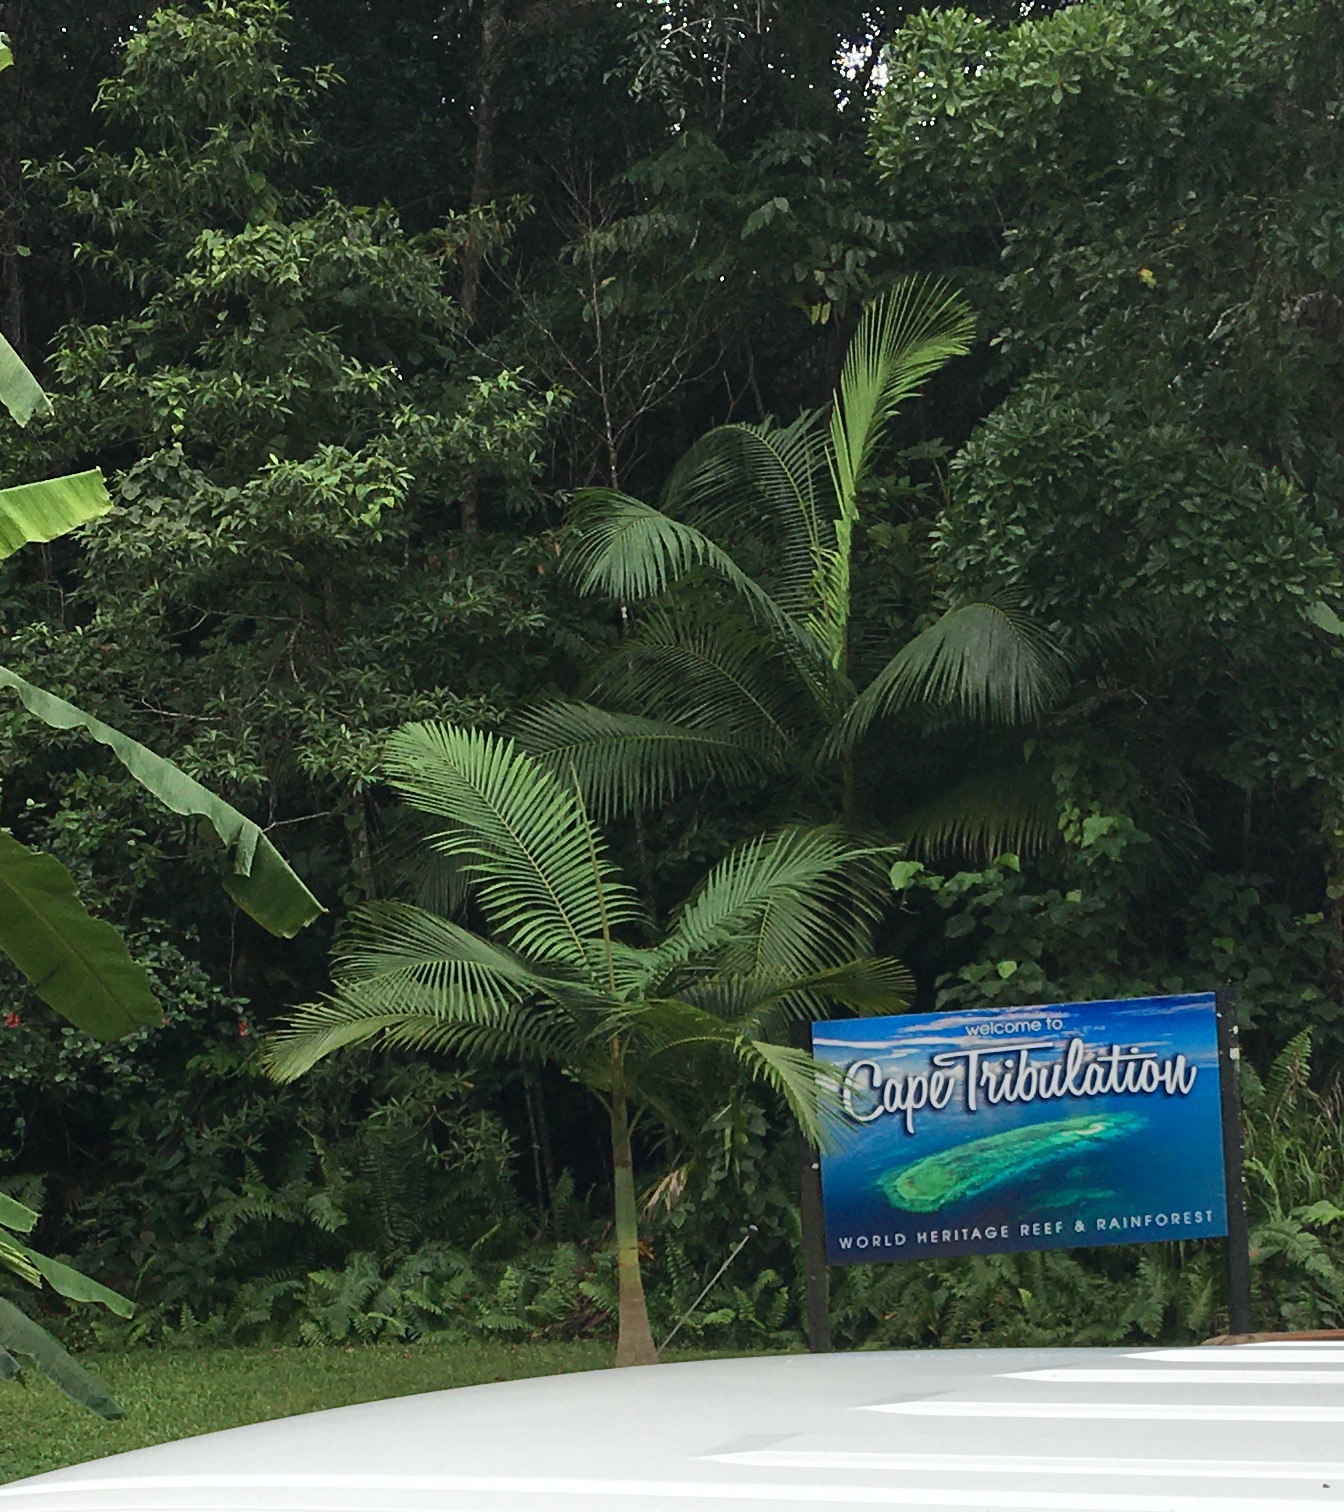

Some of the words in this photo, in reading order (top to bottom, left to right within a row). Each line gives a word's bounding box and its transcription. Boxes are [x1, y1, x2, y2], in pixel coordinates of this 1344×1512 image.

[964, 1018, 1041, 1037] welcome
[1045, 1017, 1064, 1032] to
[842, 1058, 955, 1134] Cape
[933, 1037, 1197, 1111] Tribulation
[838, 1232, 906, 1251] WORLD
[916, 1224, 1009, 1244] HERITAGE
[1020, 1220, 1063, 1237] REEF
[1074, 1219, 1086, 1233] &
[1096, 1209, 1214, 1231] RAINFOREST
